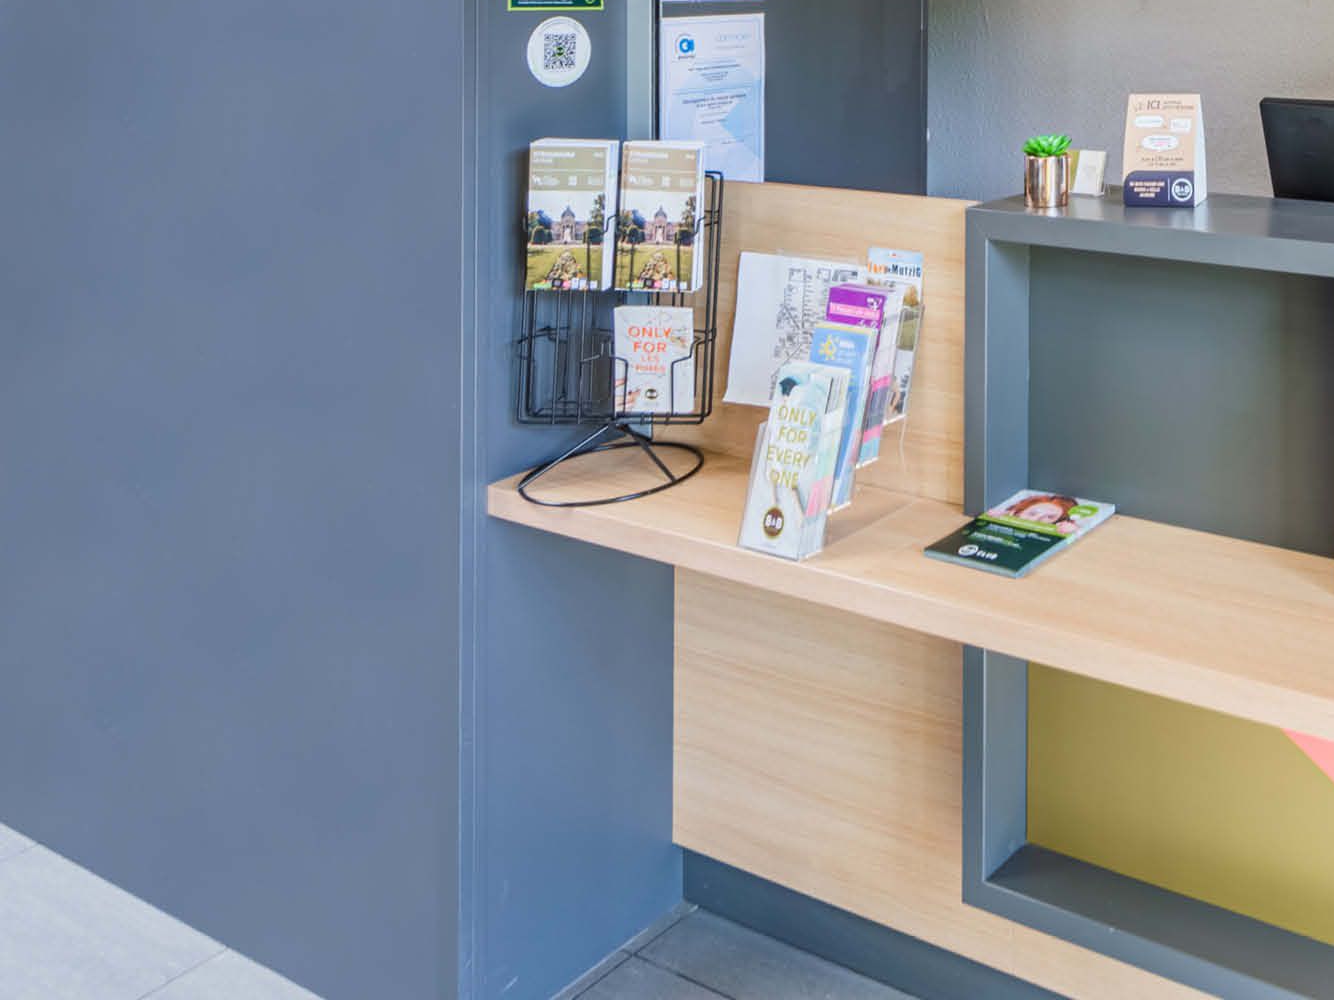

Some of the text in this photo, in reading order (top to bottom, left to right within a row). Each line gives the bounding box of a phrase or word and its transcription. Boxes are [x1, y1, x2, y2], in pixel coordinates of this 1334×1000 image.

[627, 326, 672, 339] ONLY
[633, 341, 667, 353] FOR
[778, 405, 816, 426] ONLY
[777, 426, 807, 444] FOR
[766, 443, 812, 469] EVERY
[769, 467, 800, 489] ONE
